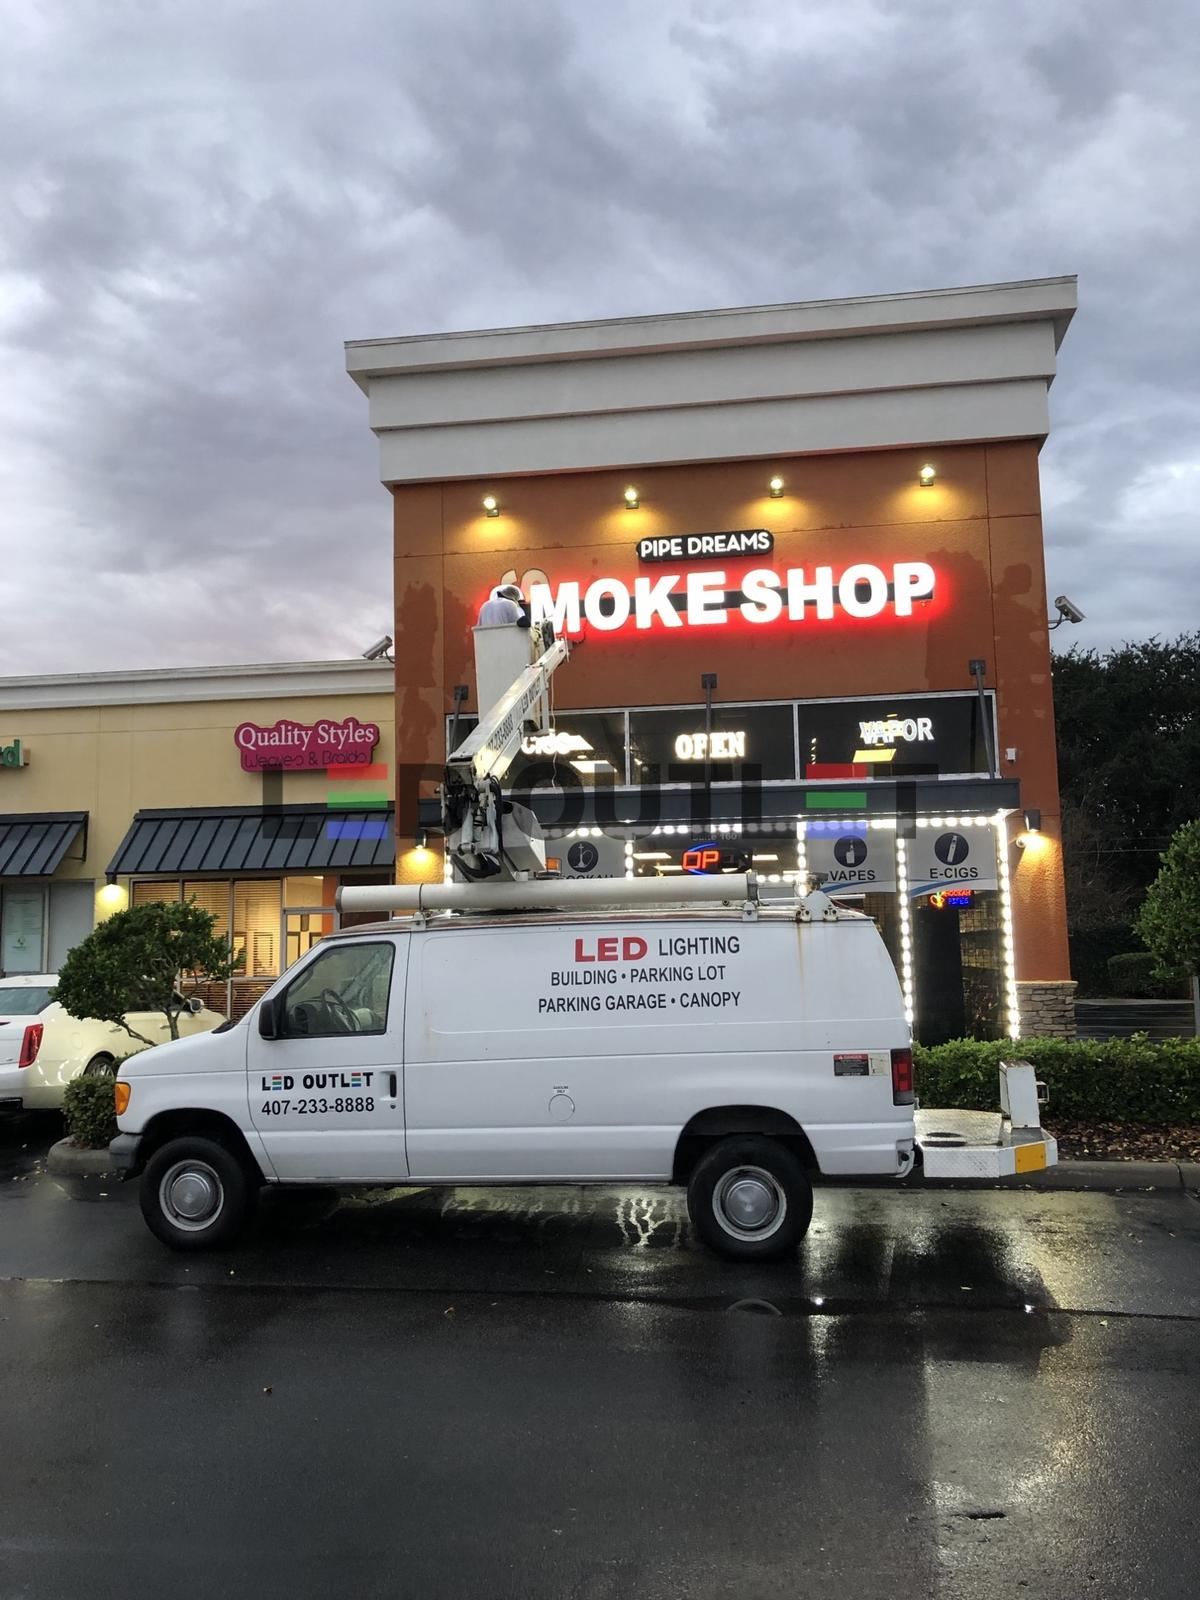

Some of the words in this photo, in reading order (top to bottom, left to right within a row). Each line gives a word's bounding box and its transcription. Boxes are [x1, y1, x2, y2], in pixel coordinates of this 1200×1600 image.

[639, 539, 682, 558] PIPE
[687, 530, 771, 555] DREAMS
[740, 561, 936, 625] SHOP
[238, 725, 313, 751] Quality
[317, 722, 374, 750] Styles
[859, 717, 935, 745] VAPOR
[674, 731, 746, 759] OPEN
[829, 870, 876, 881] VAPES
[929, 867, 978, 879] E-CIGS
[574, 936, 648, 963] LED
[658, 936, 740, 956] LIGHTING
[551, 969, 617, 986] BUILDING
[630, 966, 694, 983] PARKING
[698, 965, 726, 981] LOT
[538, 996, 601, 1013] PARKING
[605, 994, 667, 1010] GARAGE
[680, 991, 741, 1008] CANOPY
[262, 1075, 295, 1091] LED
[302, 1072, 374, 1089] OUTLET
[261, 1097, 375, 1116] 407-233-8888
